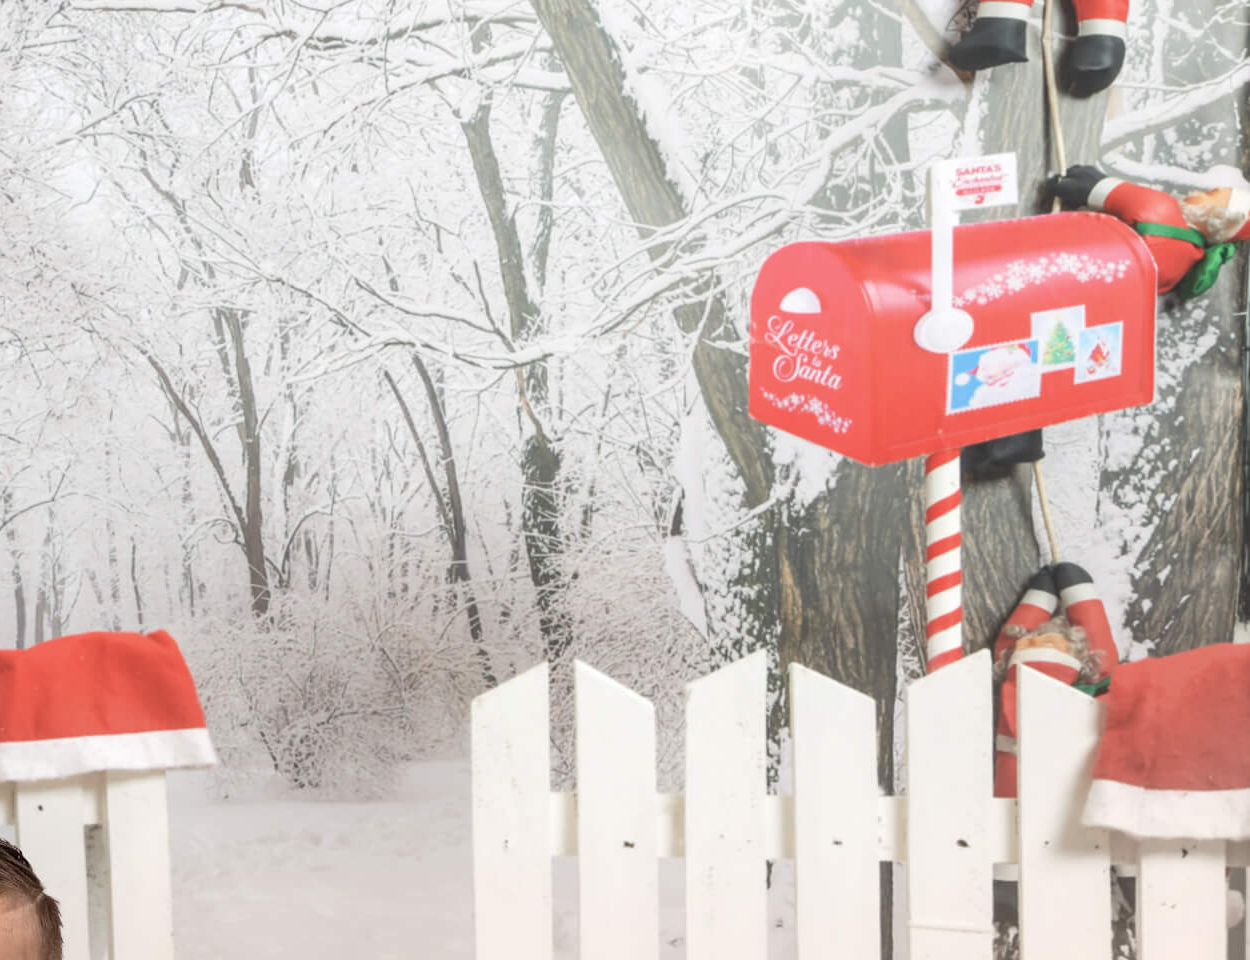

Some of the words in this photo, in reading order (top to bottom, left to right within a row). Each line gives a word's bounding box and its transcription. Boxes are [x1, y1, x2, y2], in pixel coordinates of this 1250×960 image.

[764, 315, 840, 360] Letters
[773, 353, 842, 389] Santa
[812, 355, 822, 368] to
